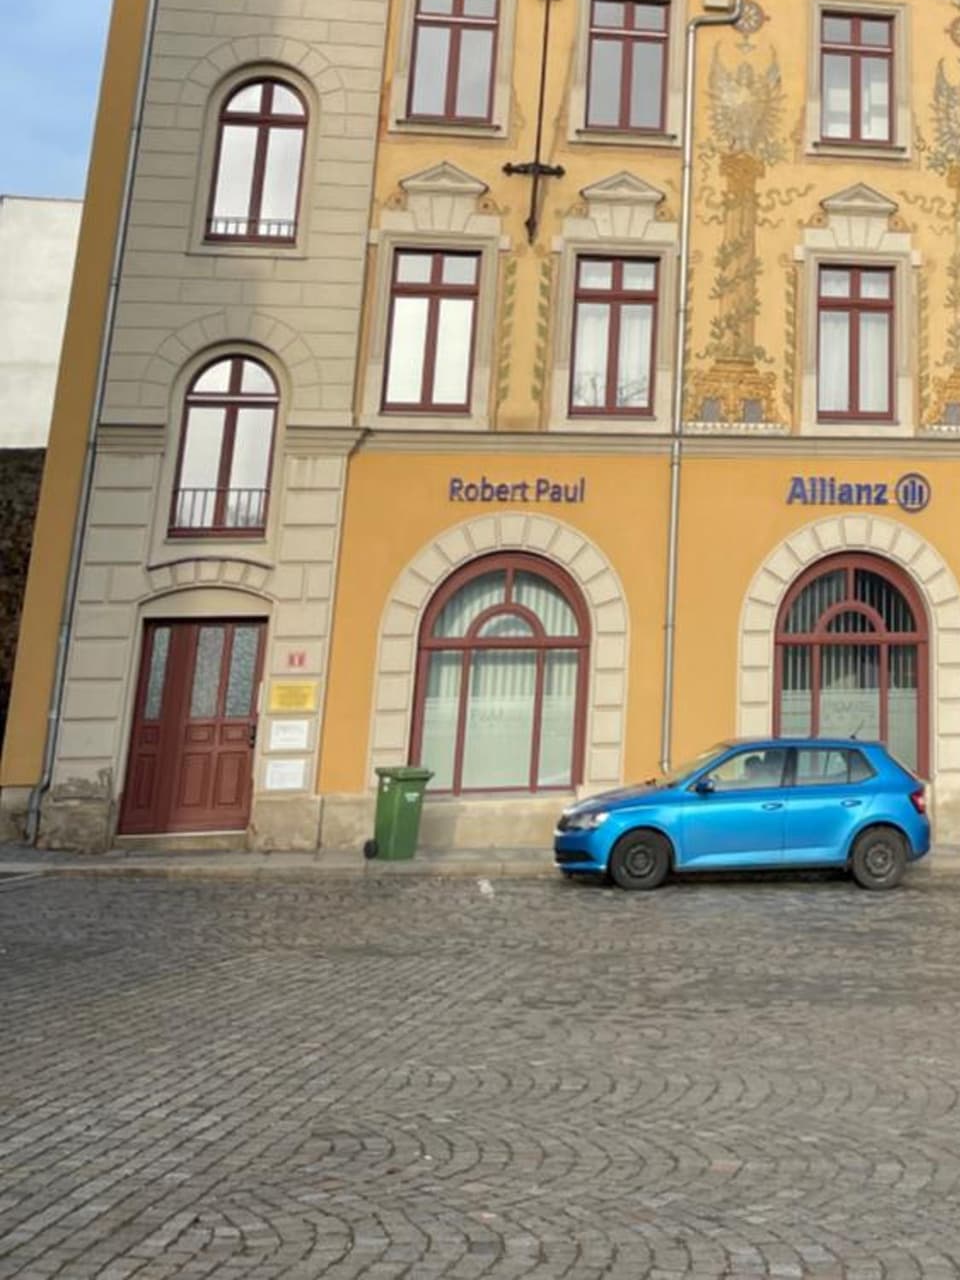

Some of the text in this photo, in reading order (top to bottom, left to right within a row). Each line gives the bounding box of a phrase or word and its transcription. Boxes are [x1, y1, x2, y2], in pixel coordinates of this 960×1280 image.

[449, 476, 586, 503] Robert Paul
[785, 476, 889, 505] Allianz
